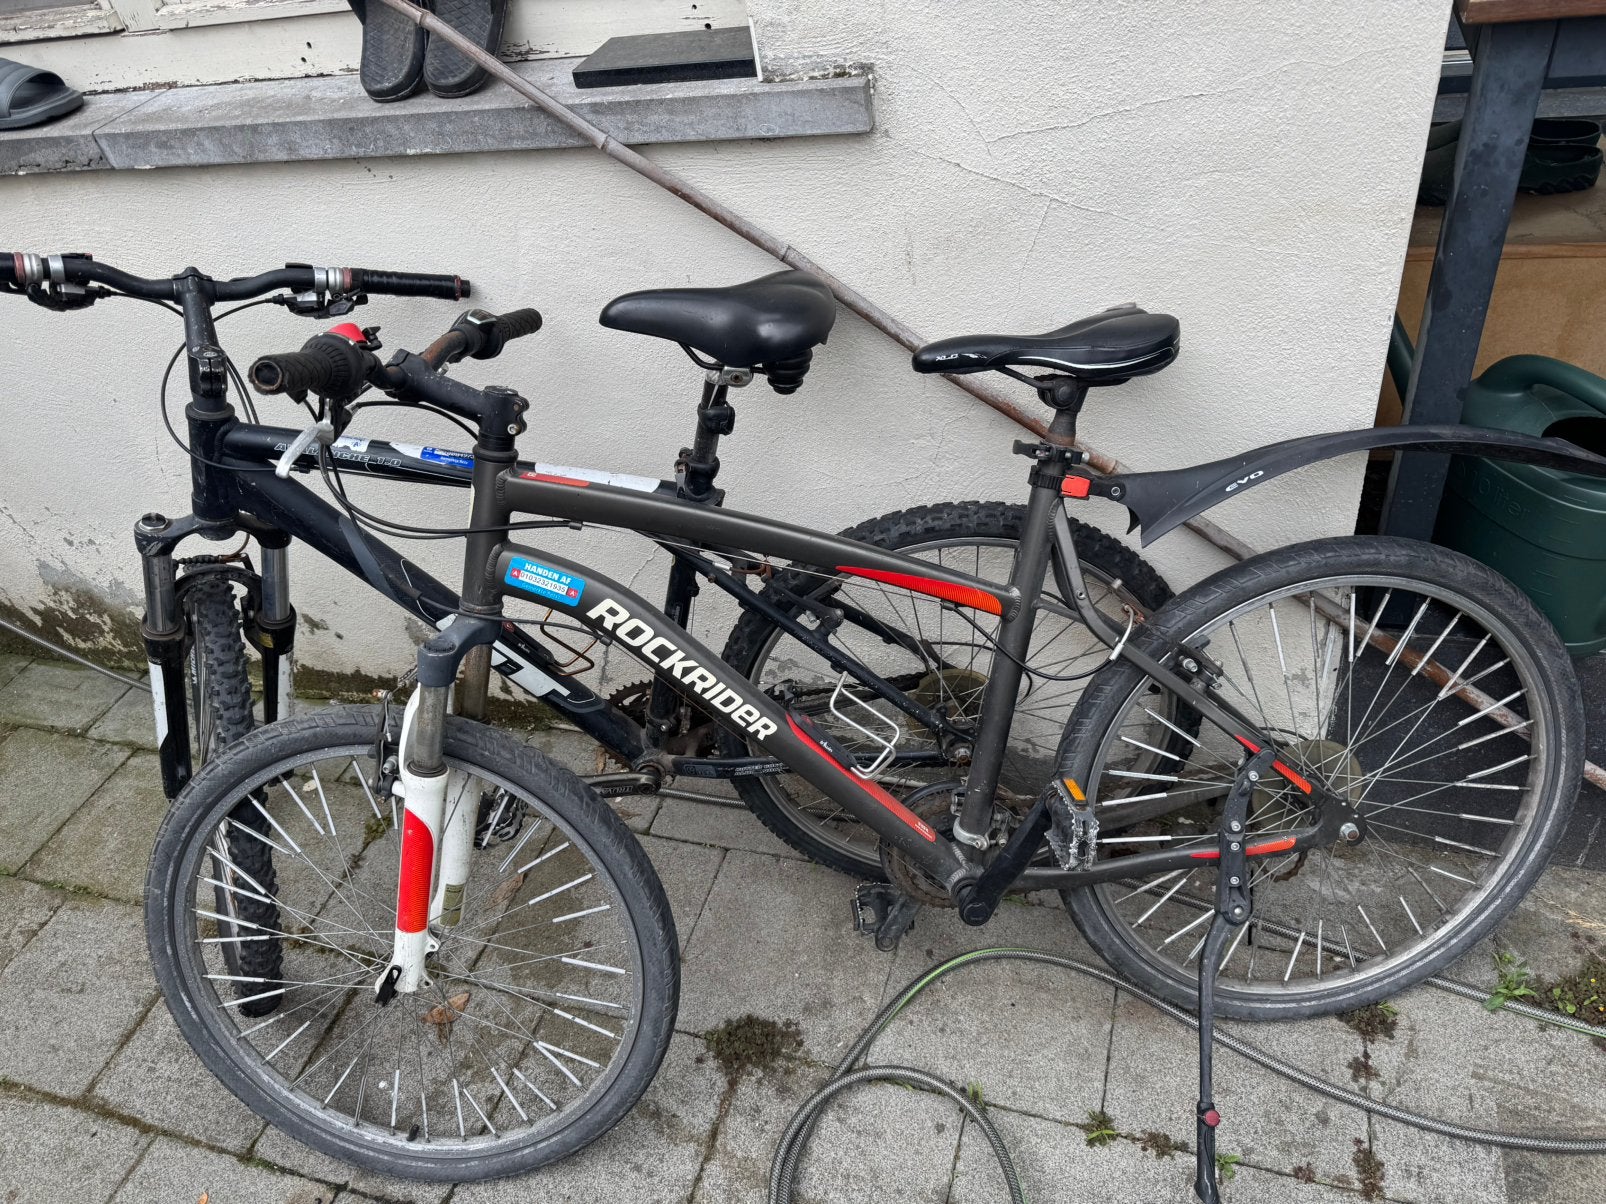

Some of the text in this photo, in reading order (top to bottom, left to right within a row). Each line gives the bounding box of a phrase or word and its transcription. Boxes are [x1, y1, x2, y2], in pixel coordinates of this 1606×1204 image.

[524, 563, 572, 585] HANDEN AF
[586, 597, 778, 742] ROCKRIDER
